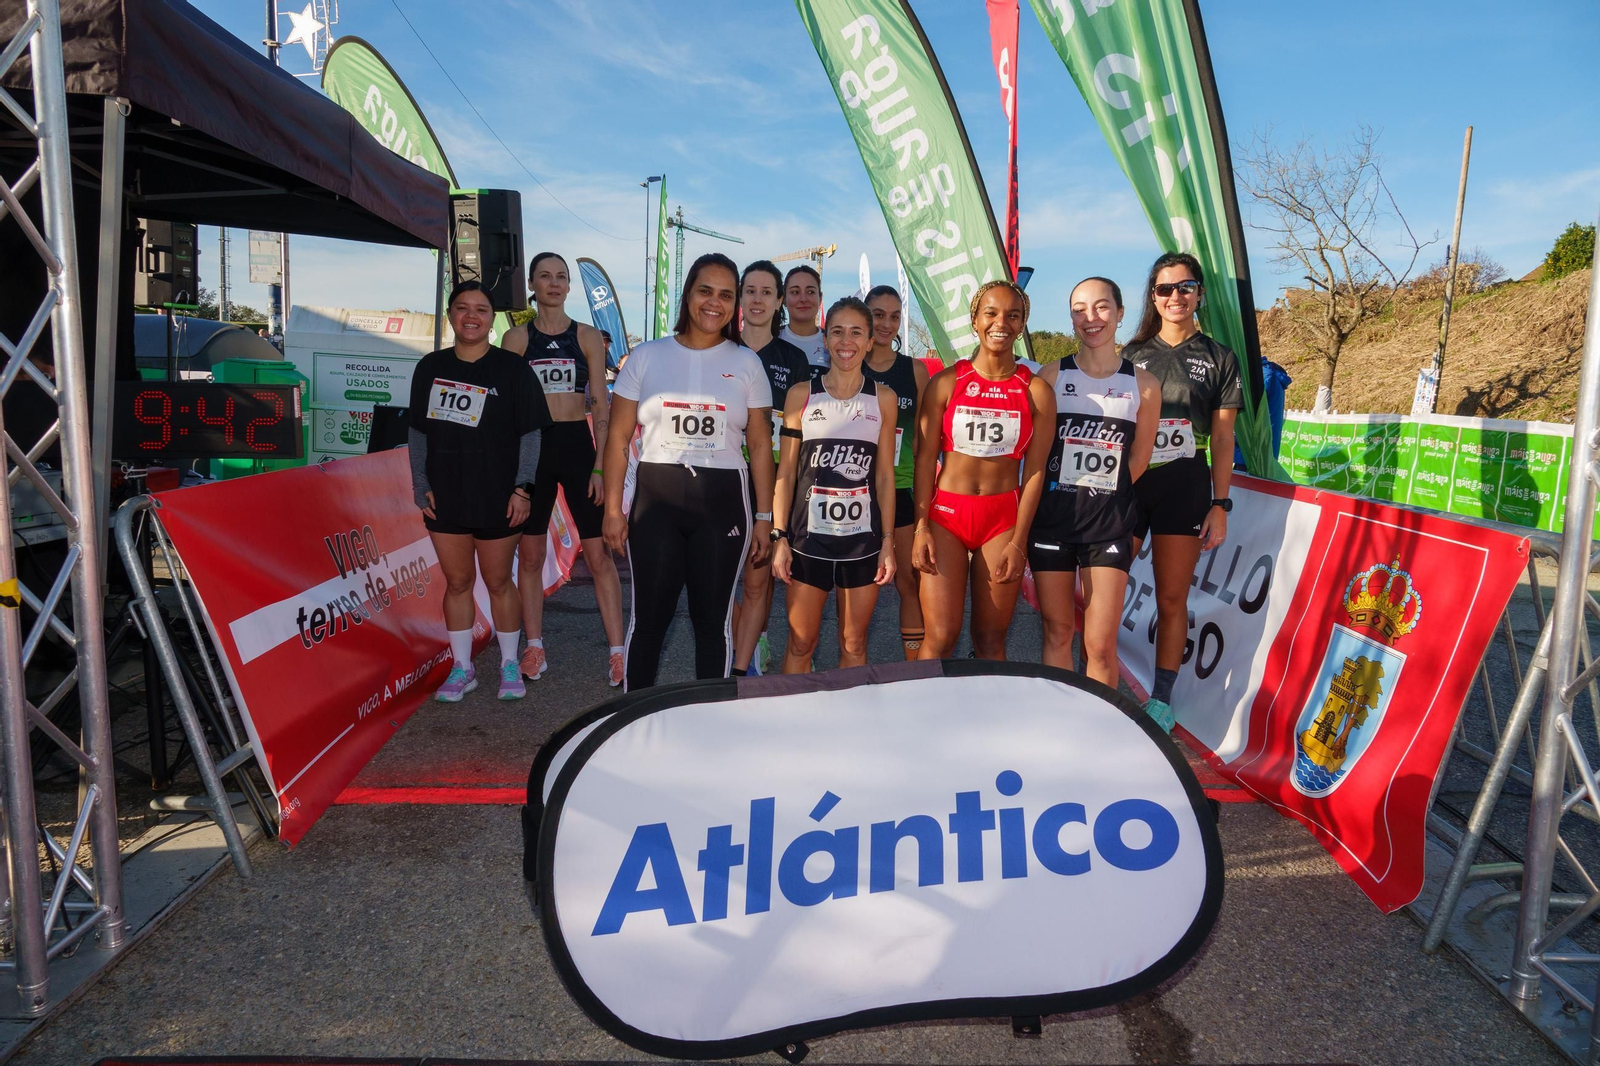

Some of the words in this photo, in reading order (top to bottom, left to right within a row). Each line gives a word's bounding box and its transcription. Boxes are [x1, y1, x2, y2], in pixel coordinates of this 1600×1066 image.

[345, 363, 391, 373] RECOLLIDA
[539, 368, 572, 384] 101
[1189, 373, 1205, 382] VIGO
[346, 379, 390, 389] USADOS
[773, 381, 787, 390] VIGO
[439, 390, 472, 412] 110
[133, 389, 285, 452] 9:42
[671, 414, 716, 436] 108
[1058, 419, 1125, 443] delikia
[965, 421, 1004, 443] 113
[1154, 429, 1184, 449] 06
[810, 444, 873, 471] delikia
[1072, 451, 1118, 474] 109
[1510, 447, 1529, 459] máis
[1535, 452, 1557, 466] auga
[844, 467, 861, 475] fresh
[1456, 476, 1472, 489] máis
[1477, 481, 1495, 494] auga
[1504, 485, 1523, 498] máis
[1530, 491, 1551, 504] auga
[817, 501, 863, 521] 100
[324, 523, 387, 580] VIGO,
[364, 572, 392, 616] de
[389, 554, 432, 598] xogo
[357, 691, 382, 721] VIGO,
[383, 684, 393, 702] A
[394, 655, 432, 695] MELLOR
[432, 646, 453, 672] CIDA
[591, 769, 1180, 937] Atlántico
